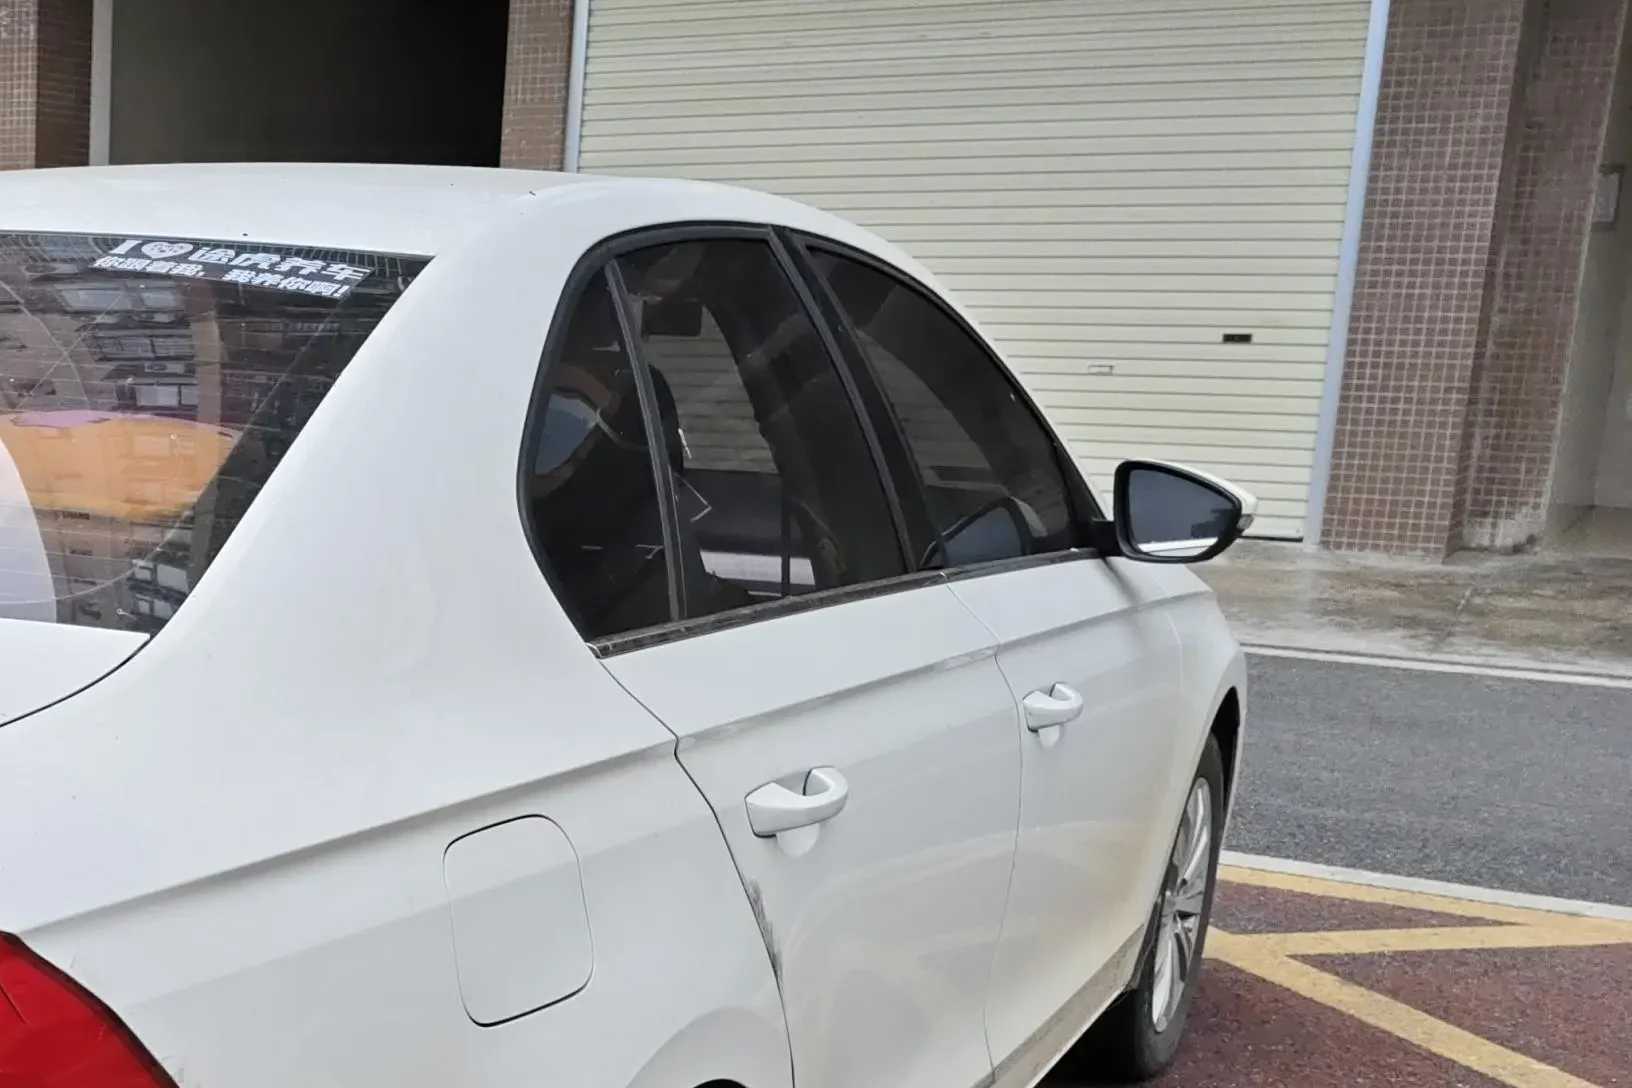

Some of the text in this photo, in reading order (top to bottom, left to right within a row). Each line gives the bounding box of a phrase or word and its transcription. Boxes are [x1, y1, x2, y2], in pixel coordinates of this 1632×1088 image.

[110, 239, 371, 281] I 途虎养车
